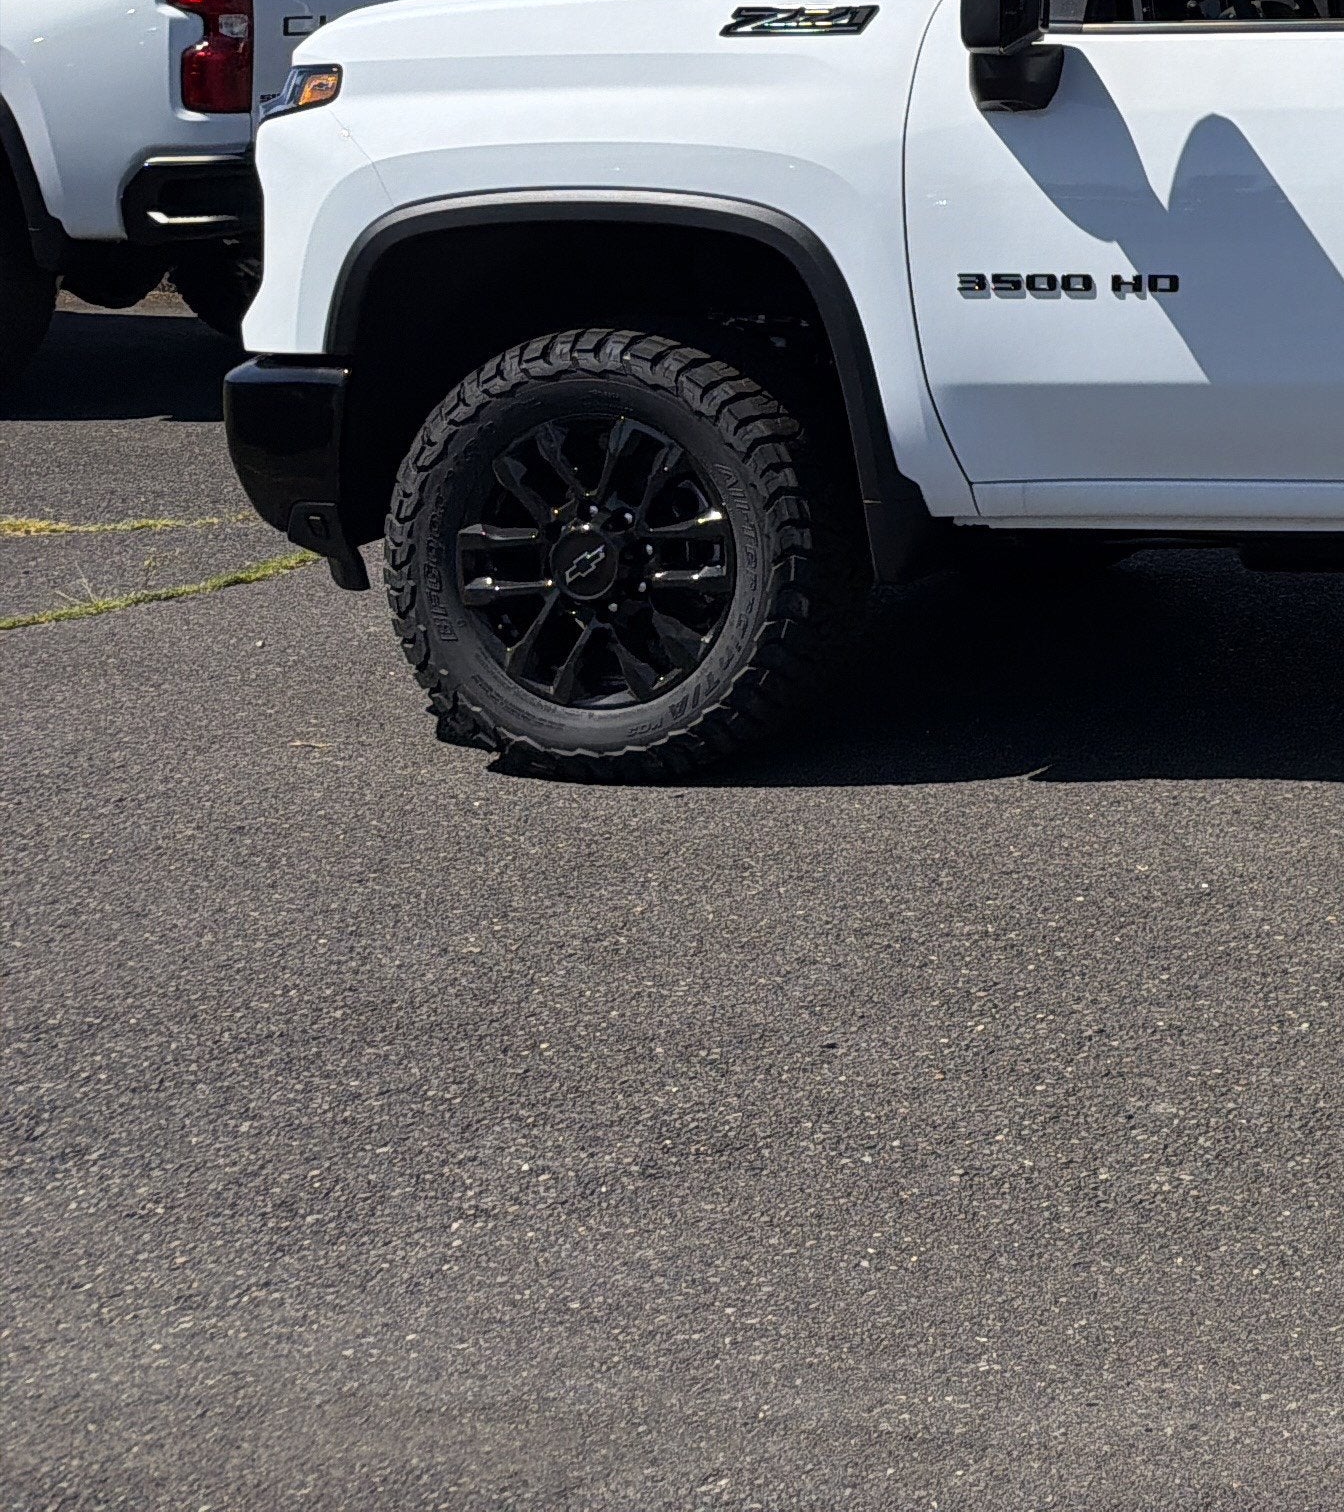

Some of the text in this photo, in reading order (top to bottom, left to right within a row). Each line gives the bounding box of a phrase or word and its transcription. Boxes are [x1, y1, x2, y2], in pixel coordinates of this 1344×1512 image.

[719, 5, 880, 38] Z71
[956, 273, 1180, 293] 3500 HD
